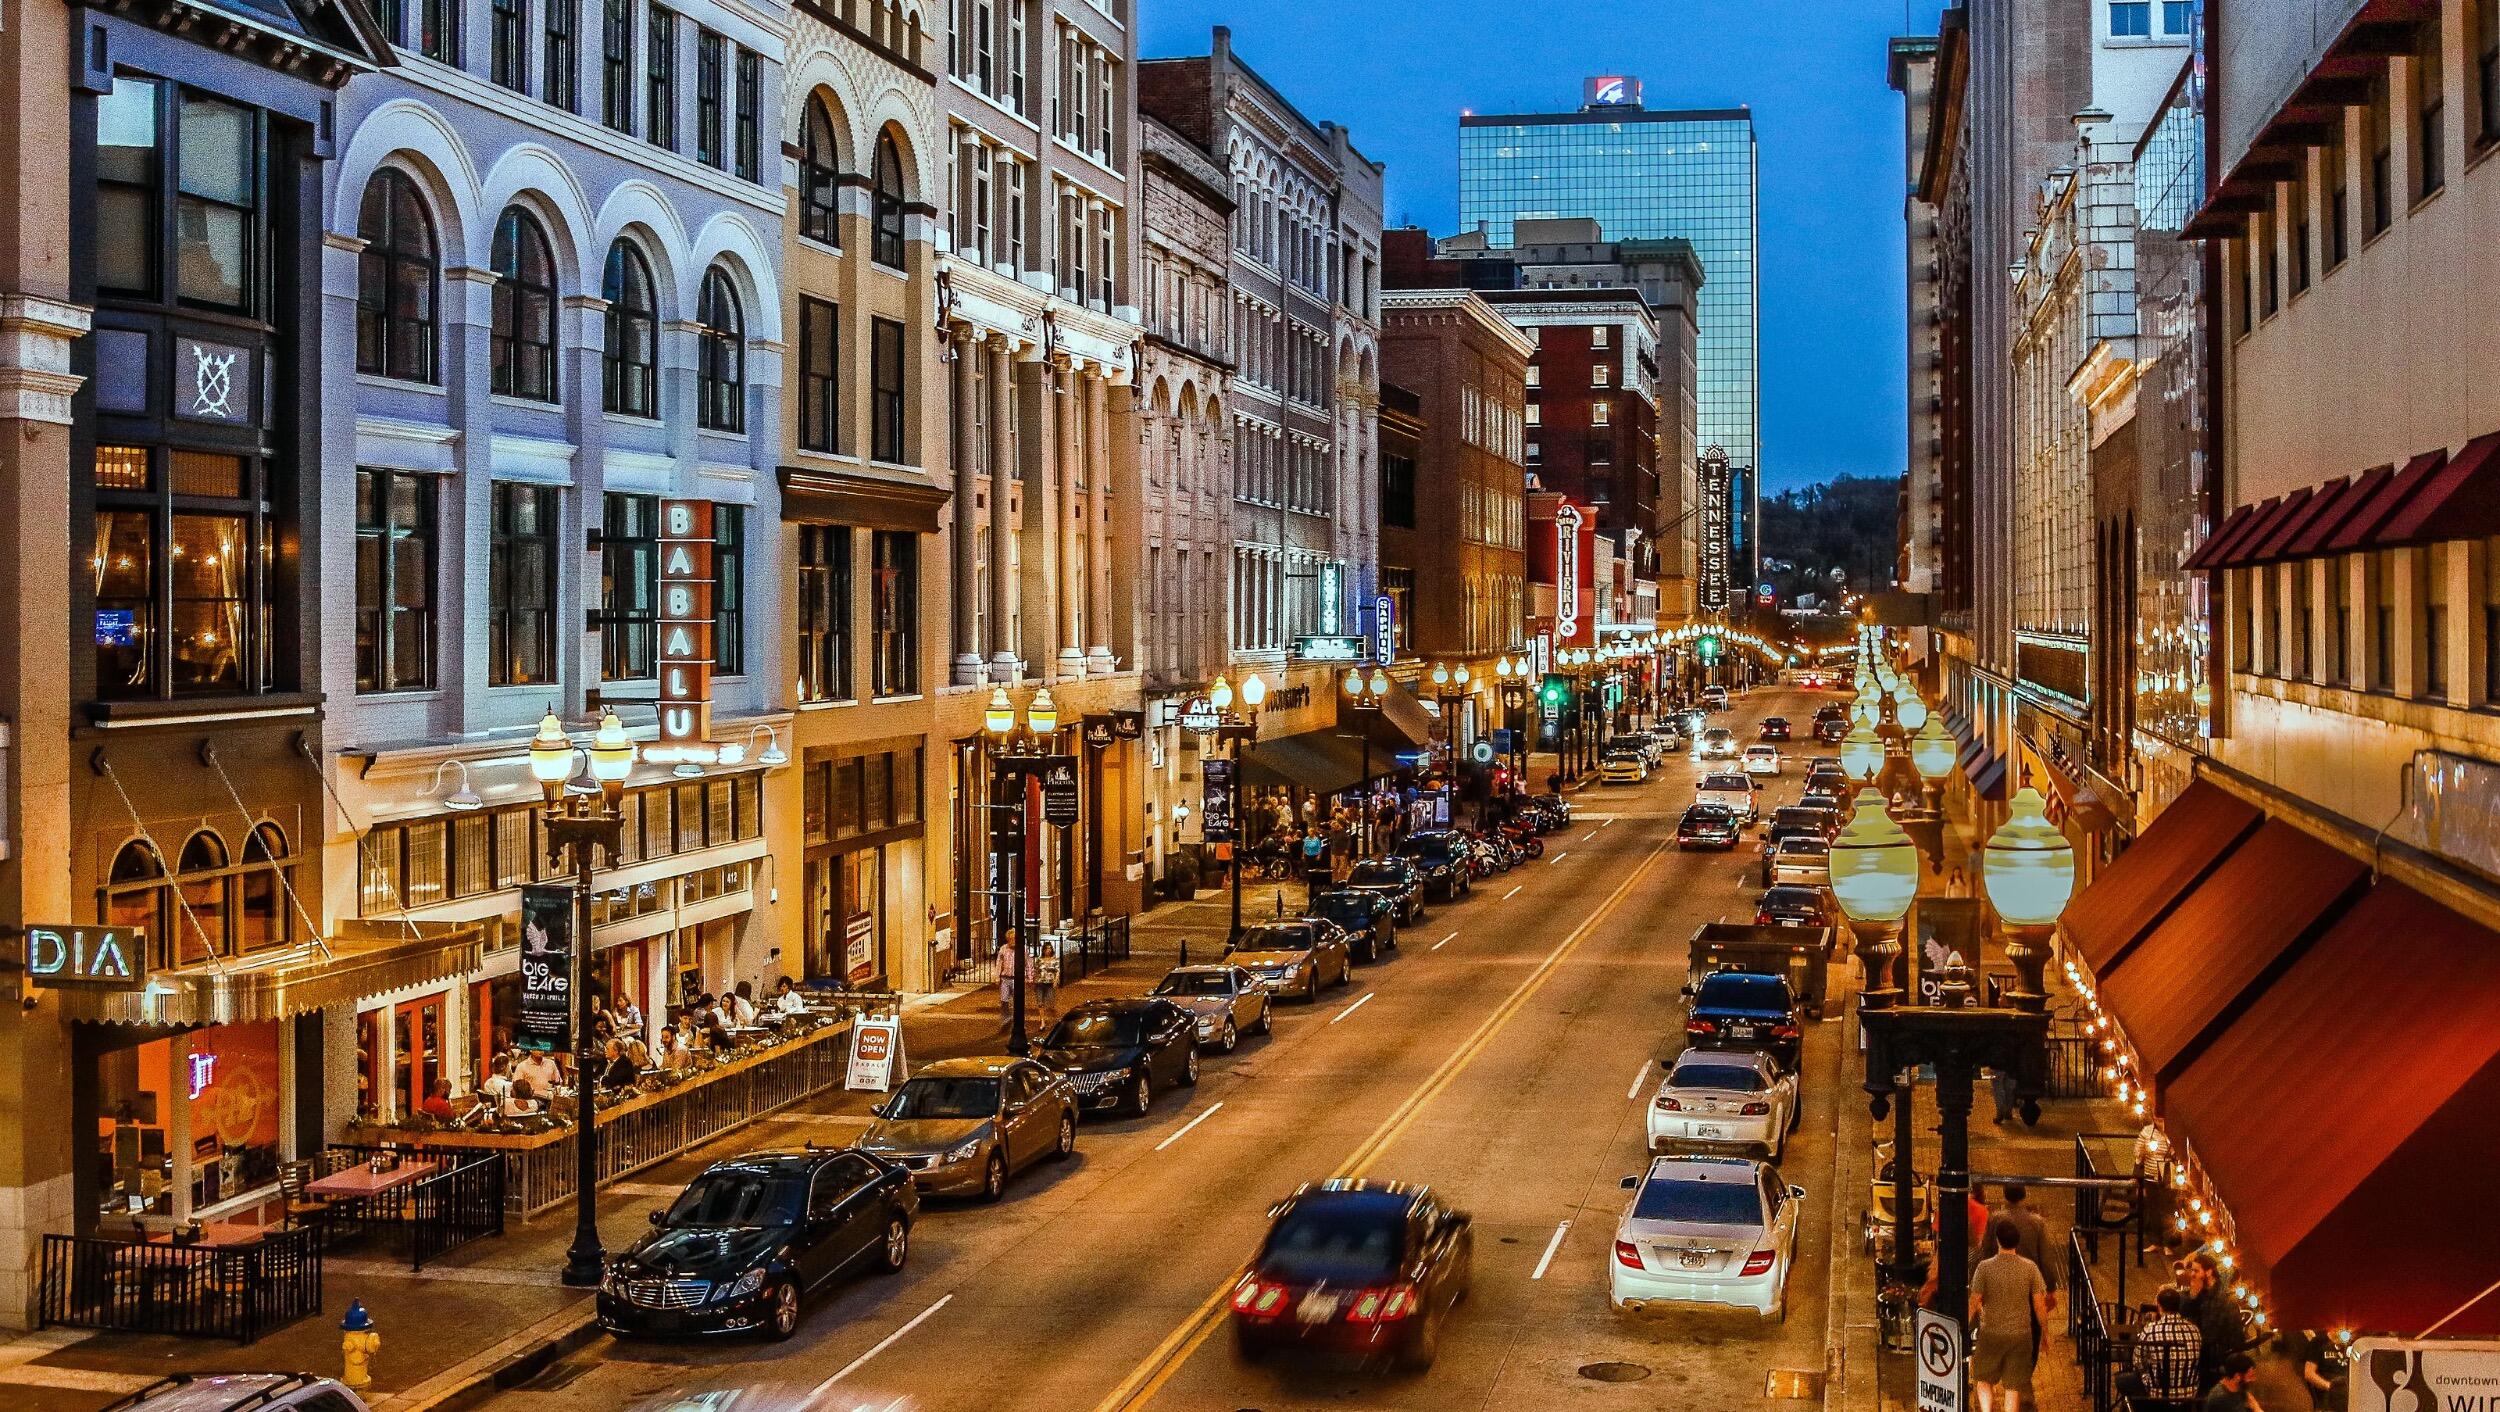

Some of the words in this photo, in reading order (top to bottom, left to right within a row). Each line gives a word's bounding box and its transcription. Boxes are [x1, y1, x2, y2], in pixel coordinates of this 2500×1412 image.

[1708, 463, 1721, 603] TENNESSEE
[1562, 525, 1572, 616] RIVIERA
[667, 506, 691, 737] BABALU
[1379, 600, 1388, 663] SAPPHIRE
[1539, 637, 1548, 671] nama
[1189, 699, 1217, 714] Art
[726, 872, 738, 884] 412
[30, 929, 130, 976] DIA
[860, 1045, 885, 1053] OPEN
[863, 1035, 886, 1044] NOW
[1920, 1380, 1955, 1409] TEMPORARY
[2435, 1374, 2499, 1386] downtown
